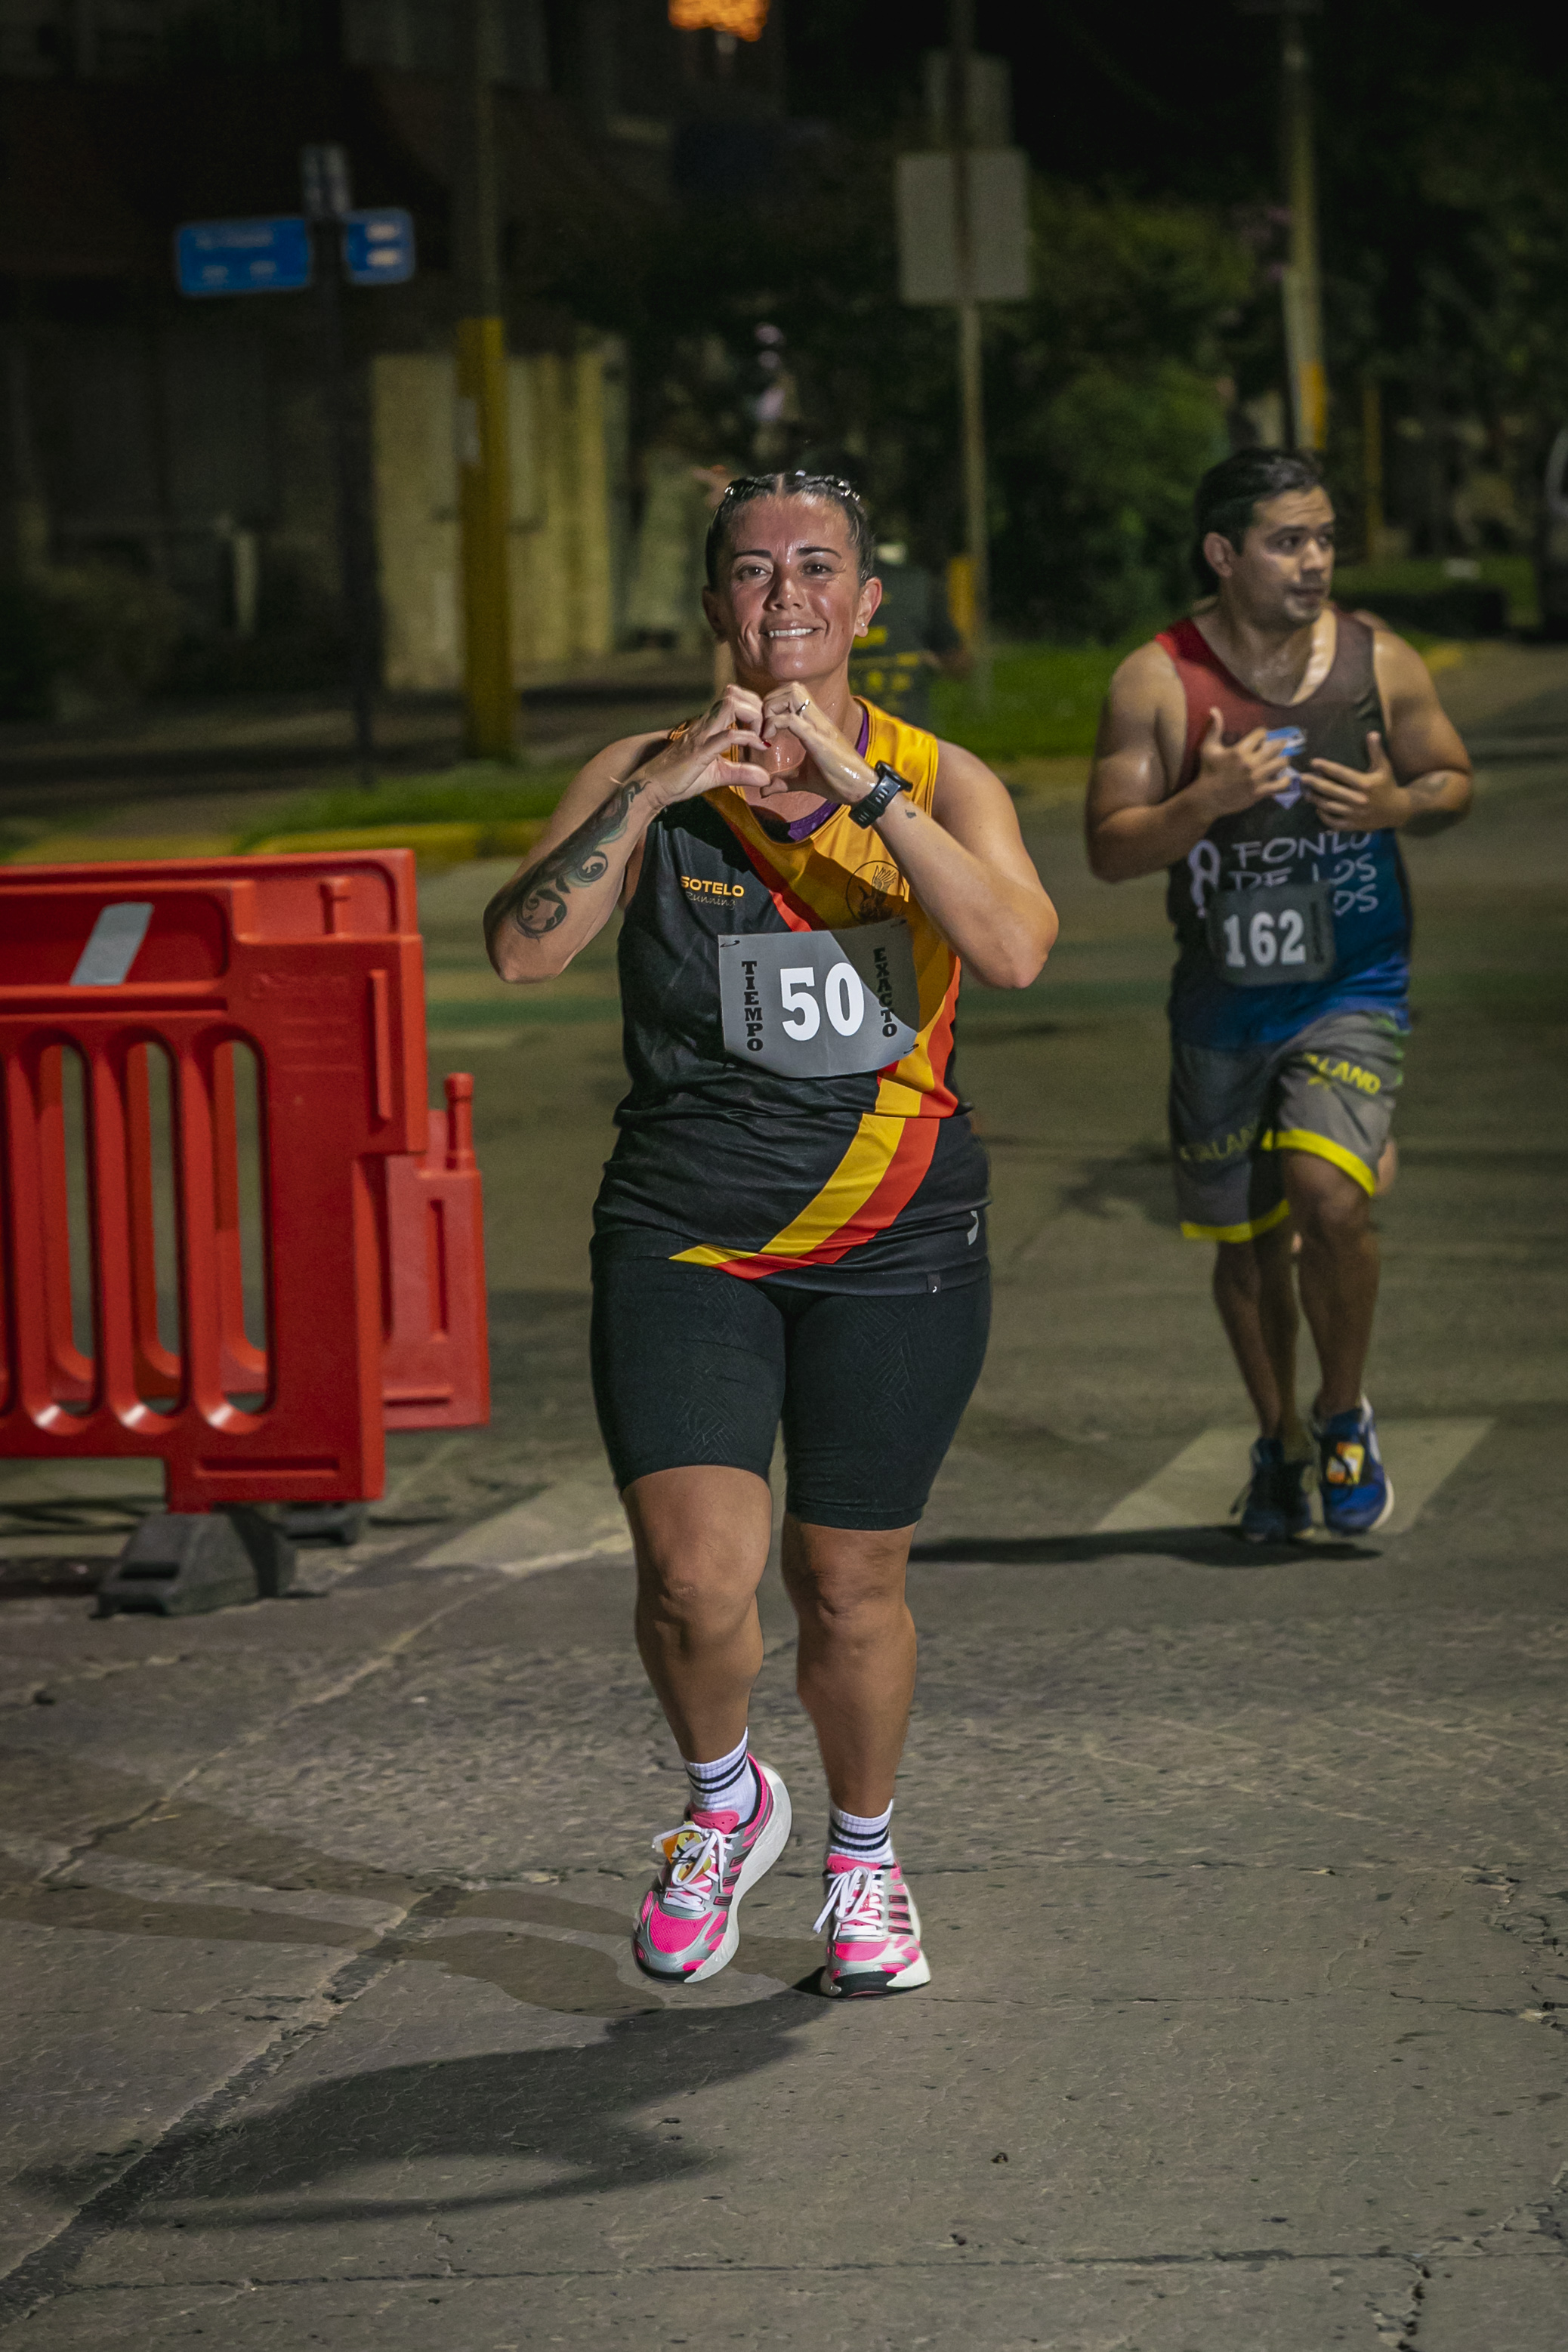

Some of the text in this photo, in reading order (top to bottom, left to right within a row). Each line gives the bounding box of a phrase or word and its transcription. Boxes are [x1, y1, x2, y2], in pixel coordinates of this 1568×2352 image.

[681, 875, 745, 897] SOTELO
[685, 890, 736, 910] Running
[1223, 908, 1306, 968] 162
[741, 946, 898, 1051] TIEMPO 50 EXACTO
